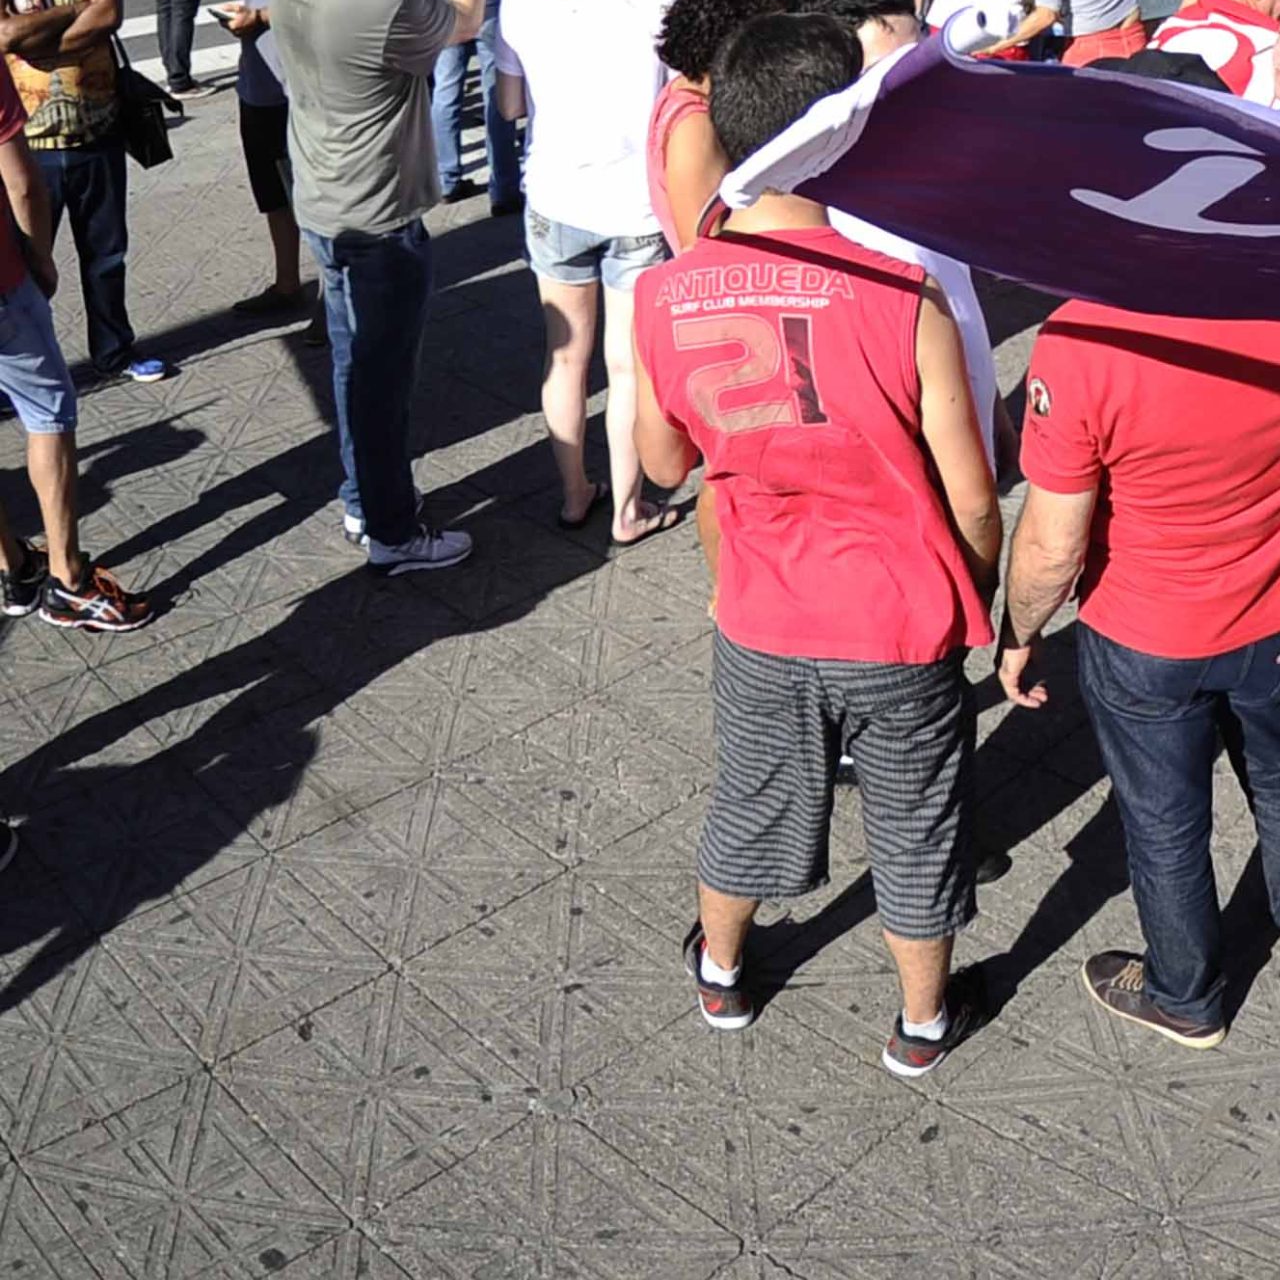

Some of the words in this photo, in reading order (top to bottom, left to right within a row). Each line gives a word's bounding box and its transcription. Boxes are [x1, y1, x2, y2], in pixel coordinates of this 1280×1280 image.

[655, 262, 855, 308] ANTIQUEDA
[670, 300, 701, 316] SURF
[703, 295, 736, 311] CLUB
[738, 294, 831, 310] MEMBERSHIP
[673, 313, 830, 433] 21
